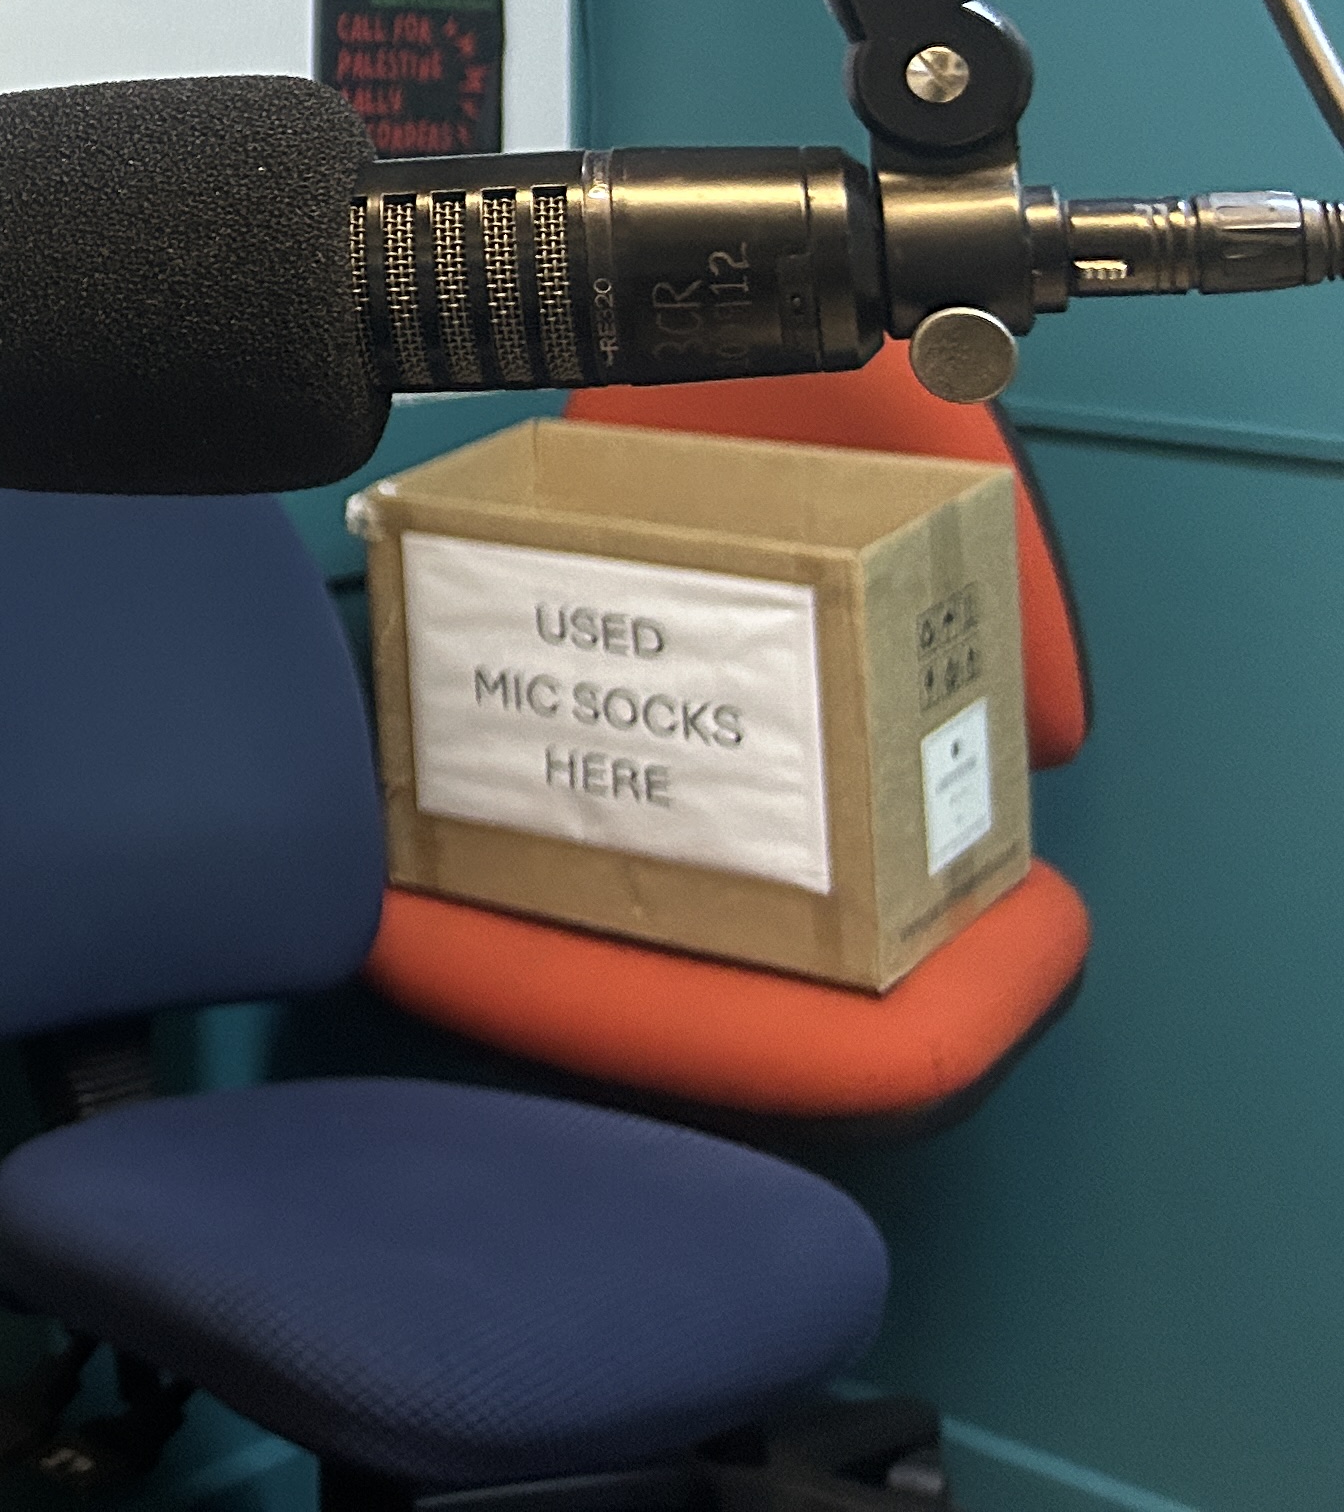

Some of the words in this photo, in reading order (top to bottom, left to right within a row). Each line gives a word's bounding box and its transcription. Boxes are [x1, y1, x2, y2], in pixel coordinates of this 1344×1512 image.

[535, 603, 665, 659] USED
[473, 664, 561, 719] MIC
[572, 687, 743, 748] SOCKS
[542, 744, 674, 808] HERE
